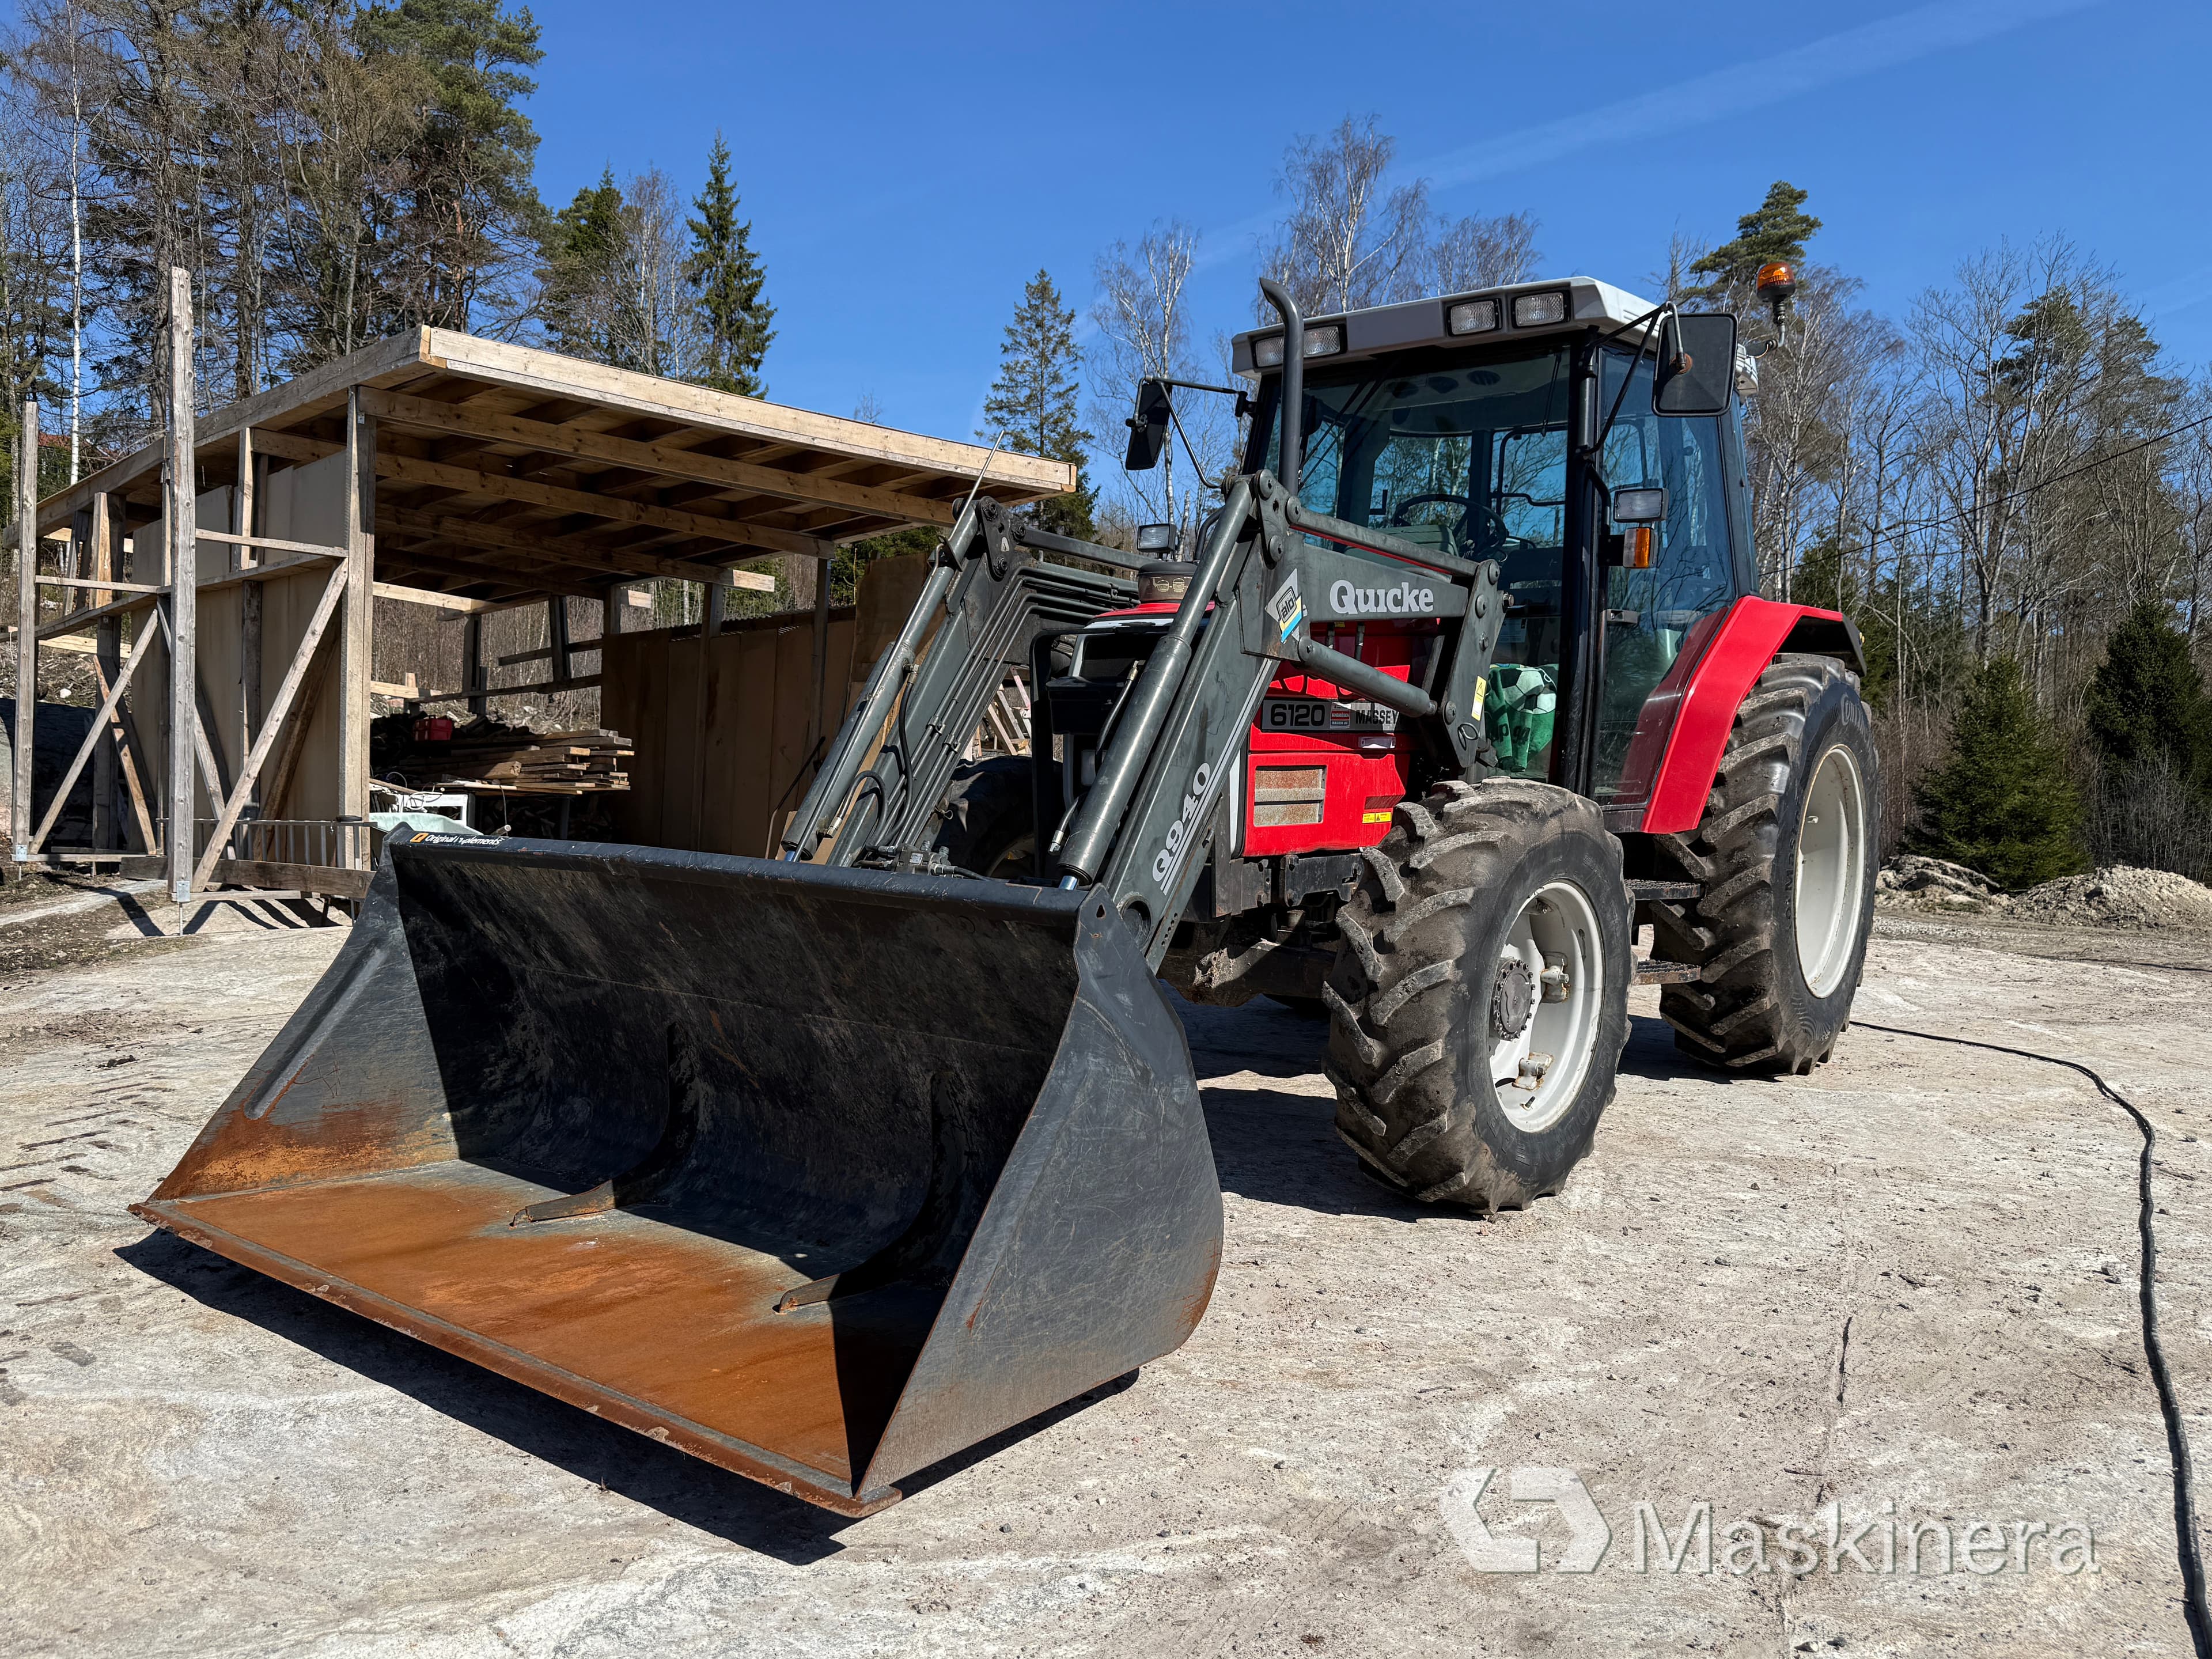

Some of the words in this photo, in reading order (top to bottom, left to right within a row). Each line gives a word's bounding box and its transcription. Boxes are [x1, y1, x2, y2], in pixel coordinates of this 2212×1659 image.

[1330, 579, 1434, 614] Quicke
[1270, 703, 1325, 726] 6120
[1355, 710, 1399, 724] MASSEY
[1152, 763, 1210, 882] Q940
[425, 835, 457, 843] Original
